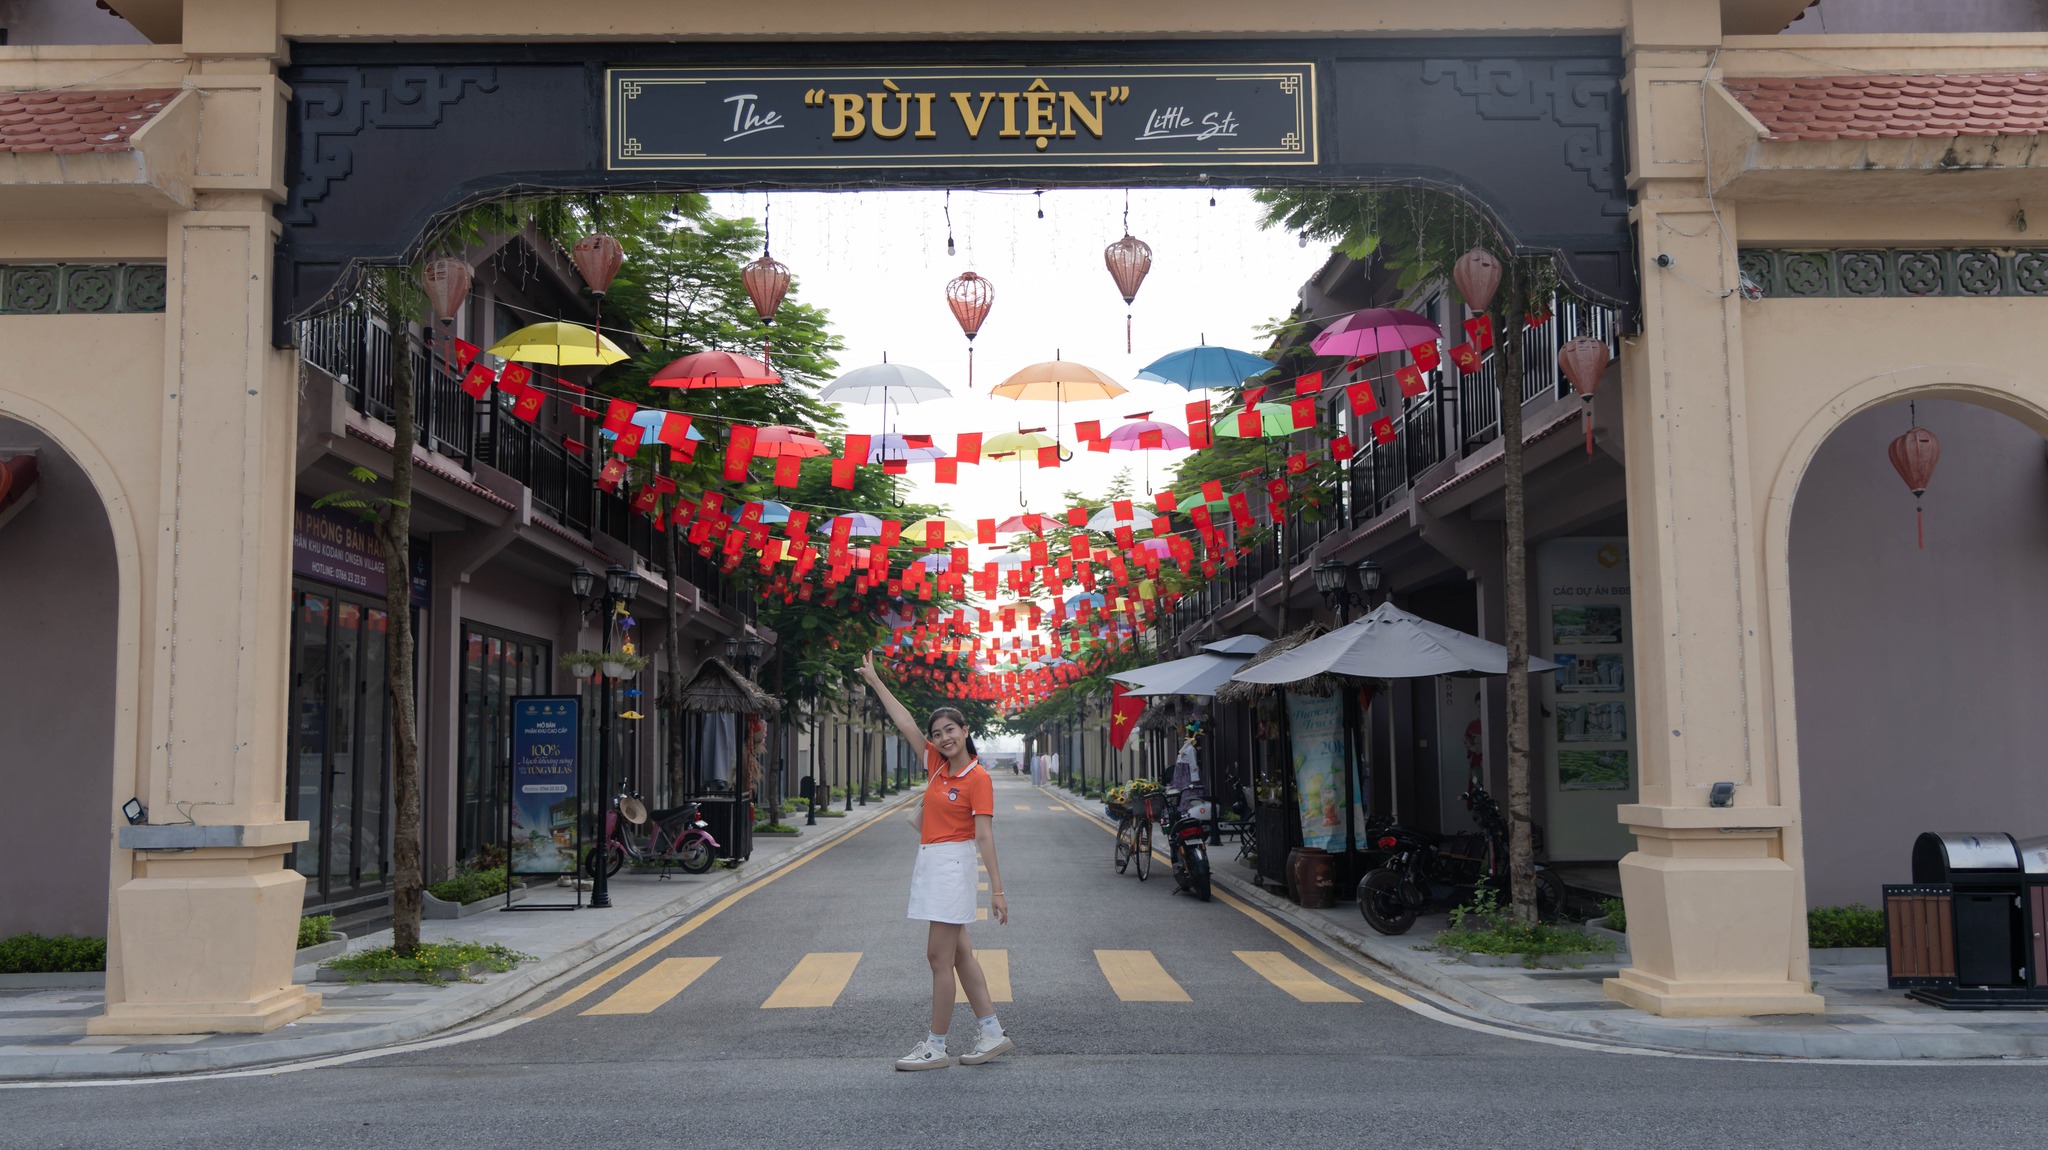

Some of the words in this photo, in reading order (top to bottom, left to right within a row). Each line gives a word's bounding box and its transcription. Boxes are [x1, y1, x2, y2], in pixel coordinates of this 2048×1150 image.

[723, 94, 783, 134] The
[1143, 106, 1193, 137] Little
[1197, 111, 1239, 141] Str
[306, 514, 343, 545] PHÒNG
[346, 526, 365, 552] BÁN
[308, 540, 321, 554] KHU
[345, 551, 363, 567] ONSEN
[363, 558, 385, 574] VILLAGE
[1553, 584, 1574, 596] CÁC
[1595, 584, 1609, 596] ÁN
[532, 745, 560, 756] 100%
